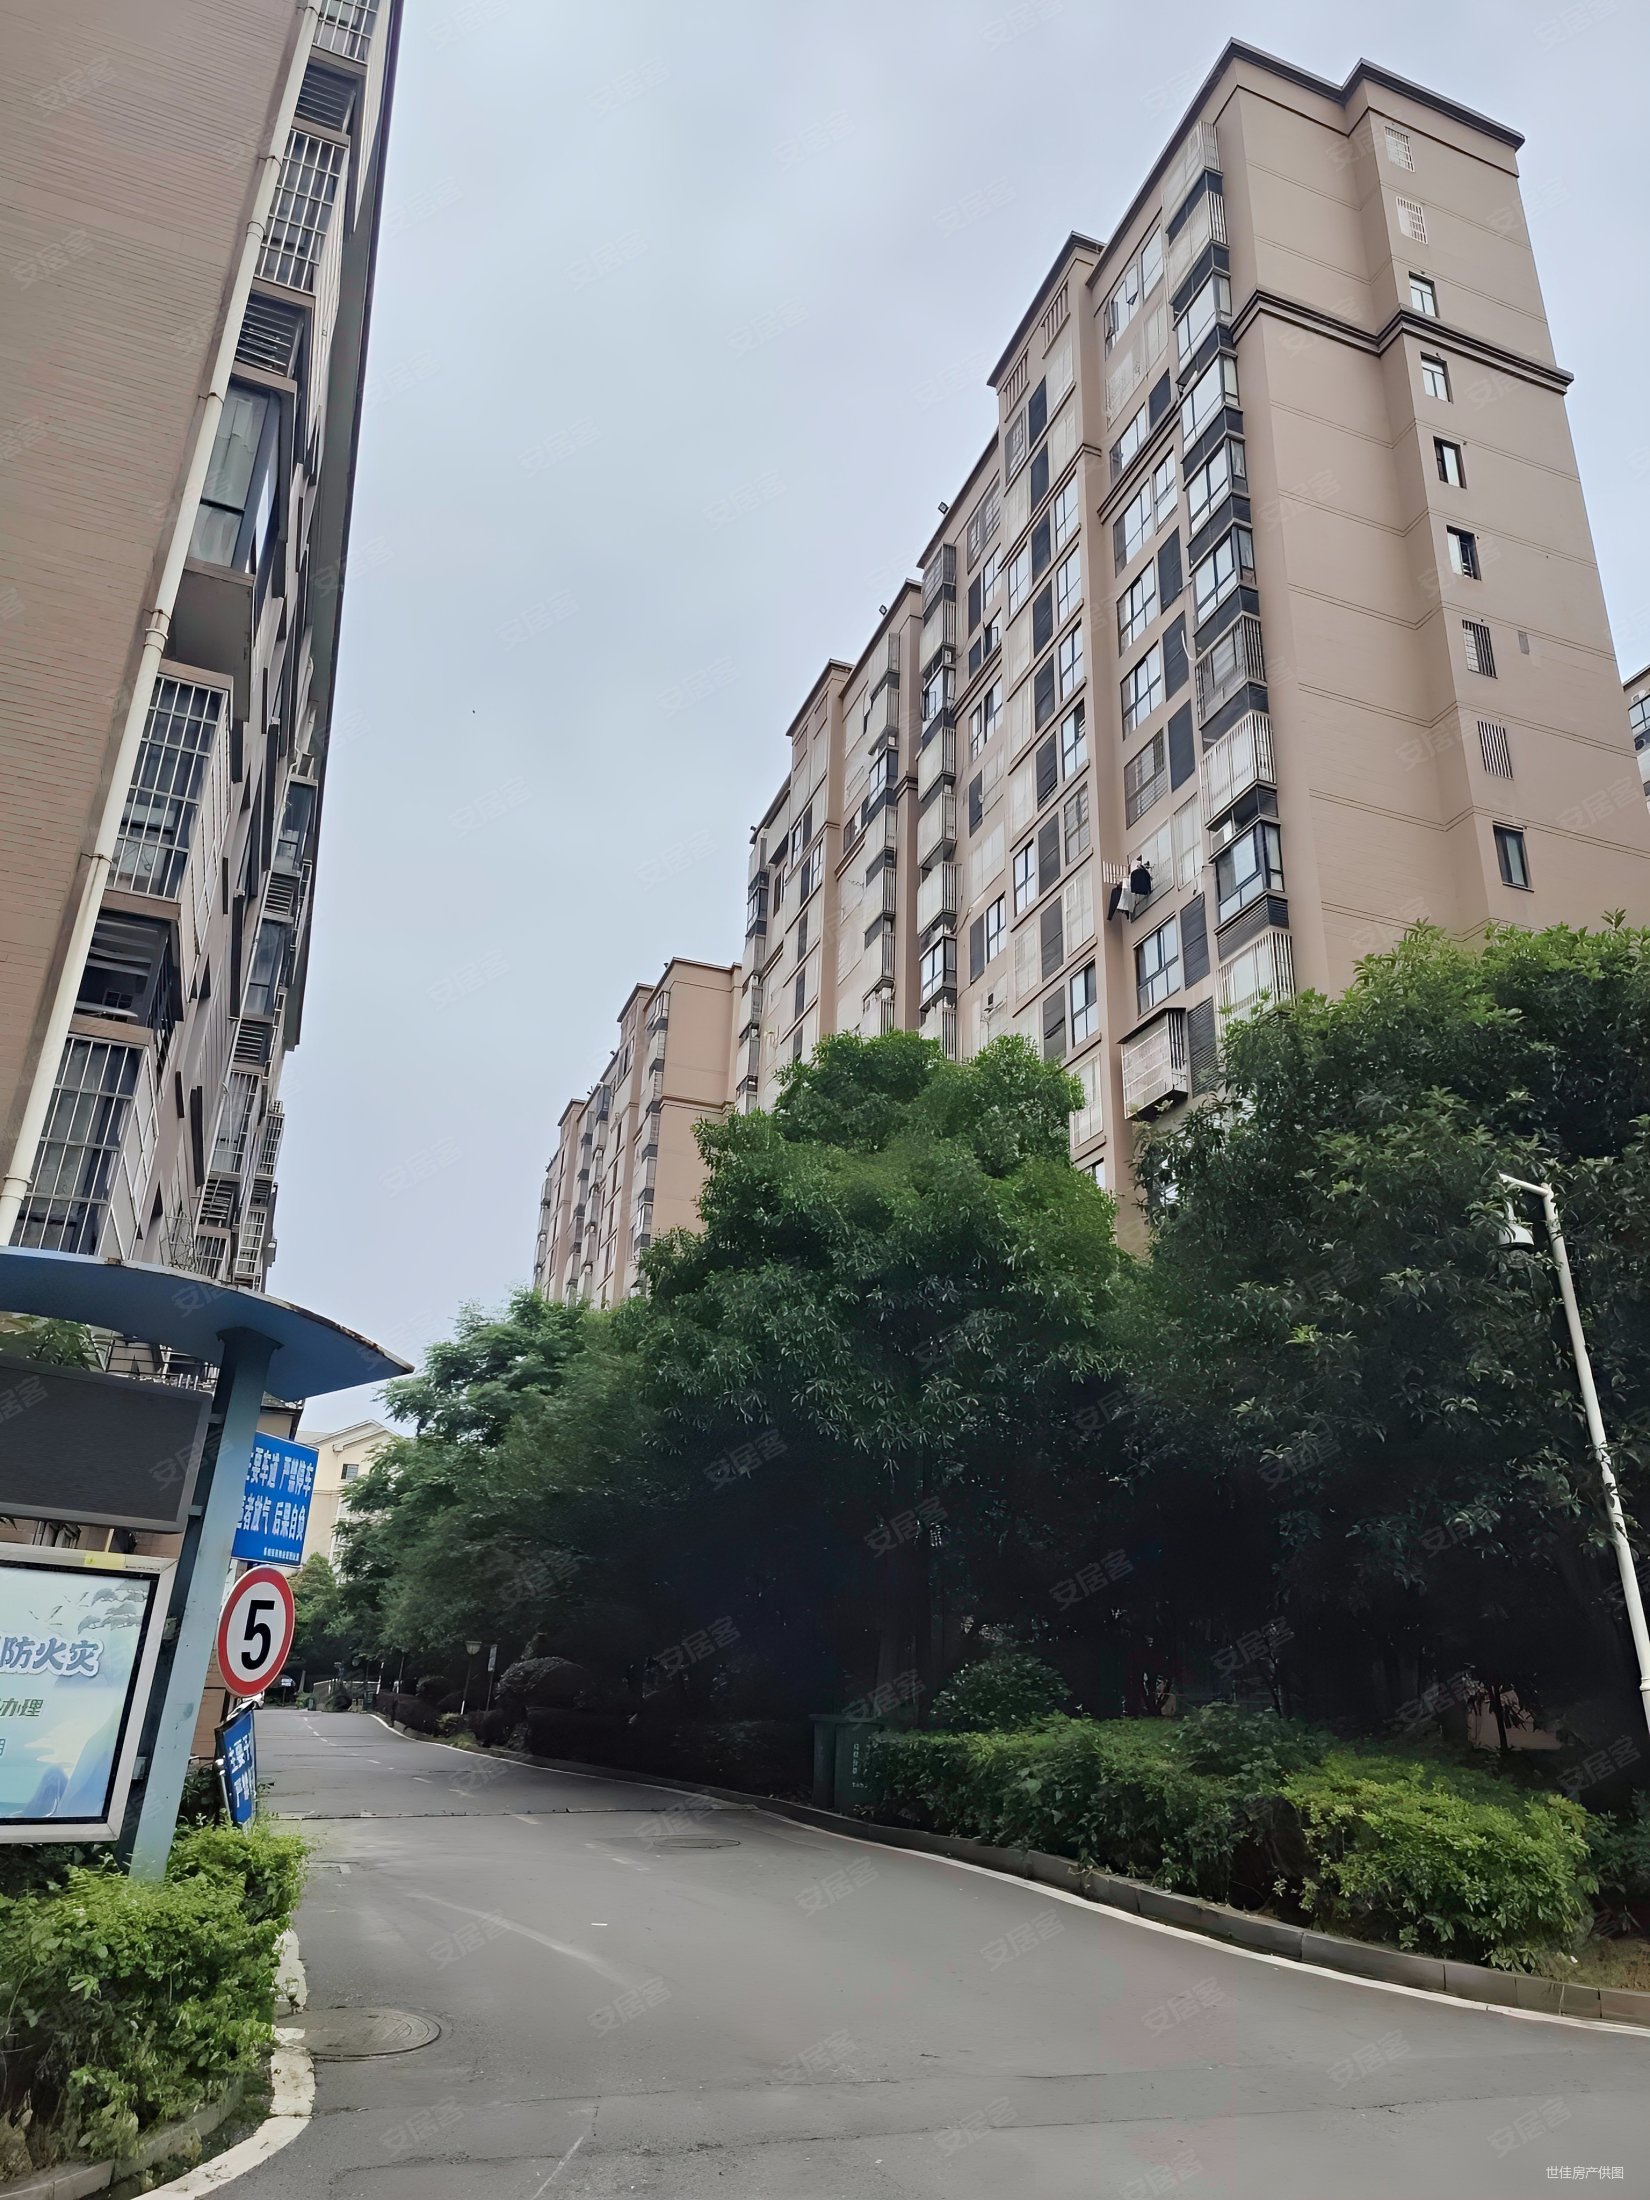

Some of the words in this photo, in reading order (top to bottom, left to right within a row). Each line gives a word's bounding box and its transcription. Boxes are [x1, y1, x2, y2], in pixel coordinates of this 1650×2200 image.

[272, 1501, 306, 1542] 后果自负
[0, 1636, 98, 1672] 防火灾
[240, 1599, 275, 1671] 5
[233, 1768, 254, 1808] 严禁
